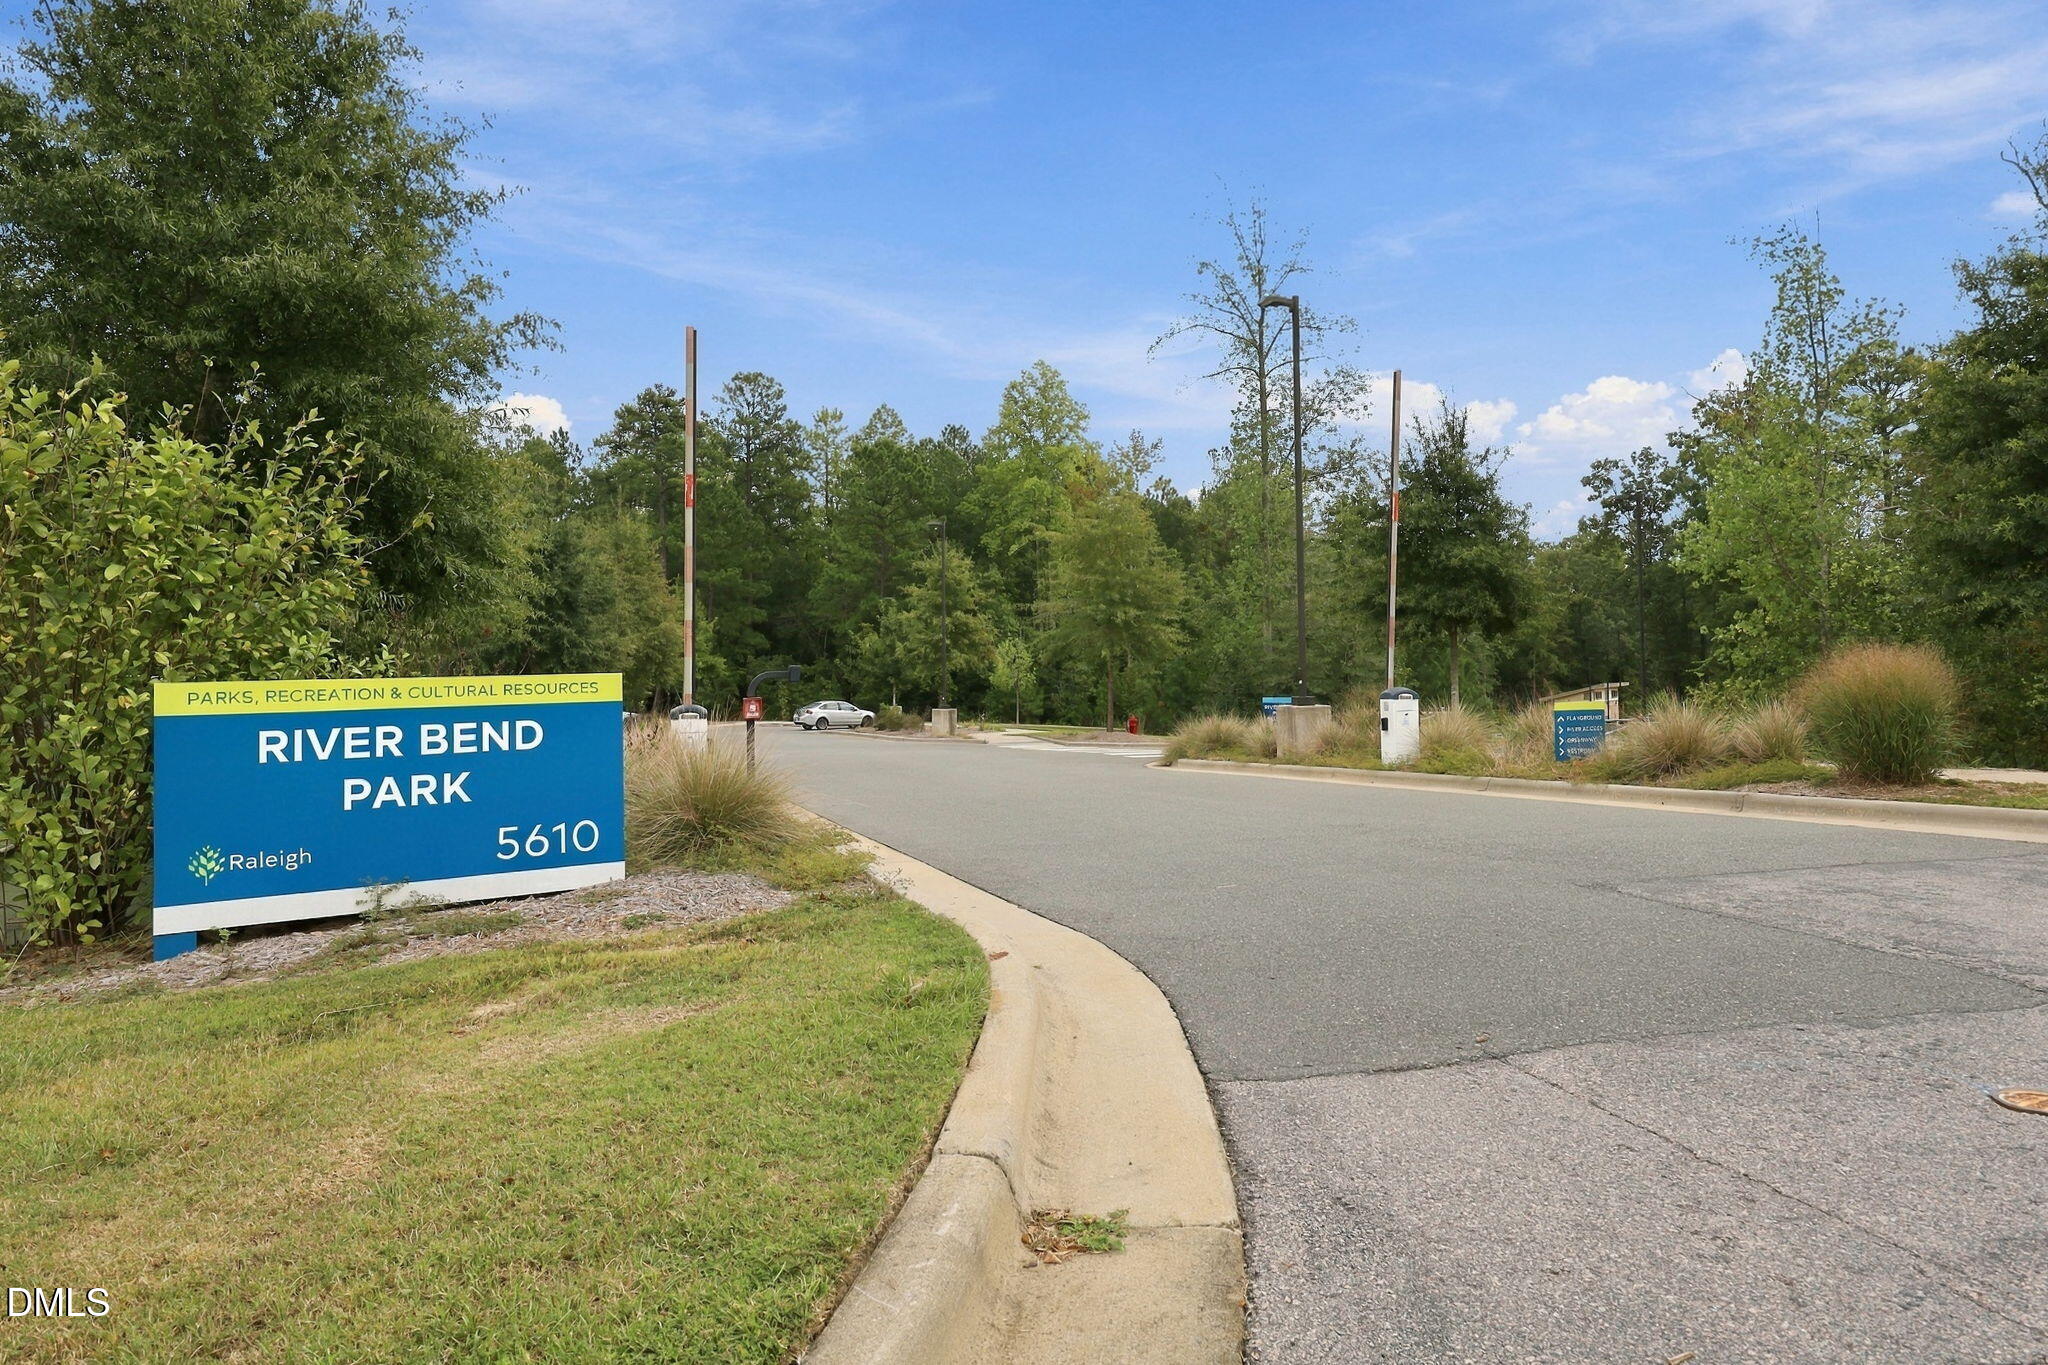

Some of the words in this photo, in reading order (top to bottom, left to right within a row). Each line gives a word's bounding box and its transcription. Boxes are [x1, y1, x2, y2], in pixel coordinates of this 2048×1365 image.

[187, 690, 259, 706] PARKS,
[265, 687, 385, 703] RECREATION
[390, 687, 402, 700] &
[408, 684, 498, 699] CULTURAL
[503, 681, 599, 697] RESOURCES
[258, 725, 404, 764] RIVER
[420, 719, 544, 756] BEND
[343, 771, 473, 811] PARK
[229, 848, 313, 871] Raleigh
[496, 819, 600, 860] 5610
